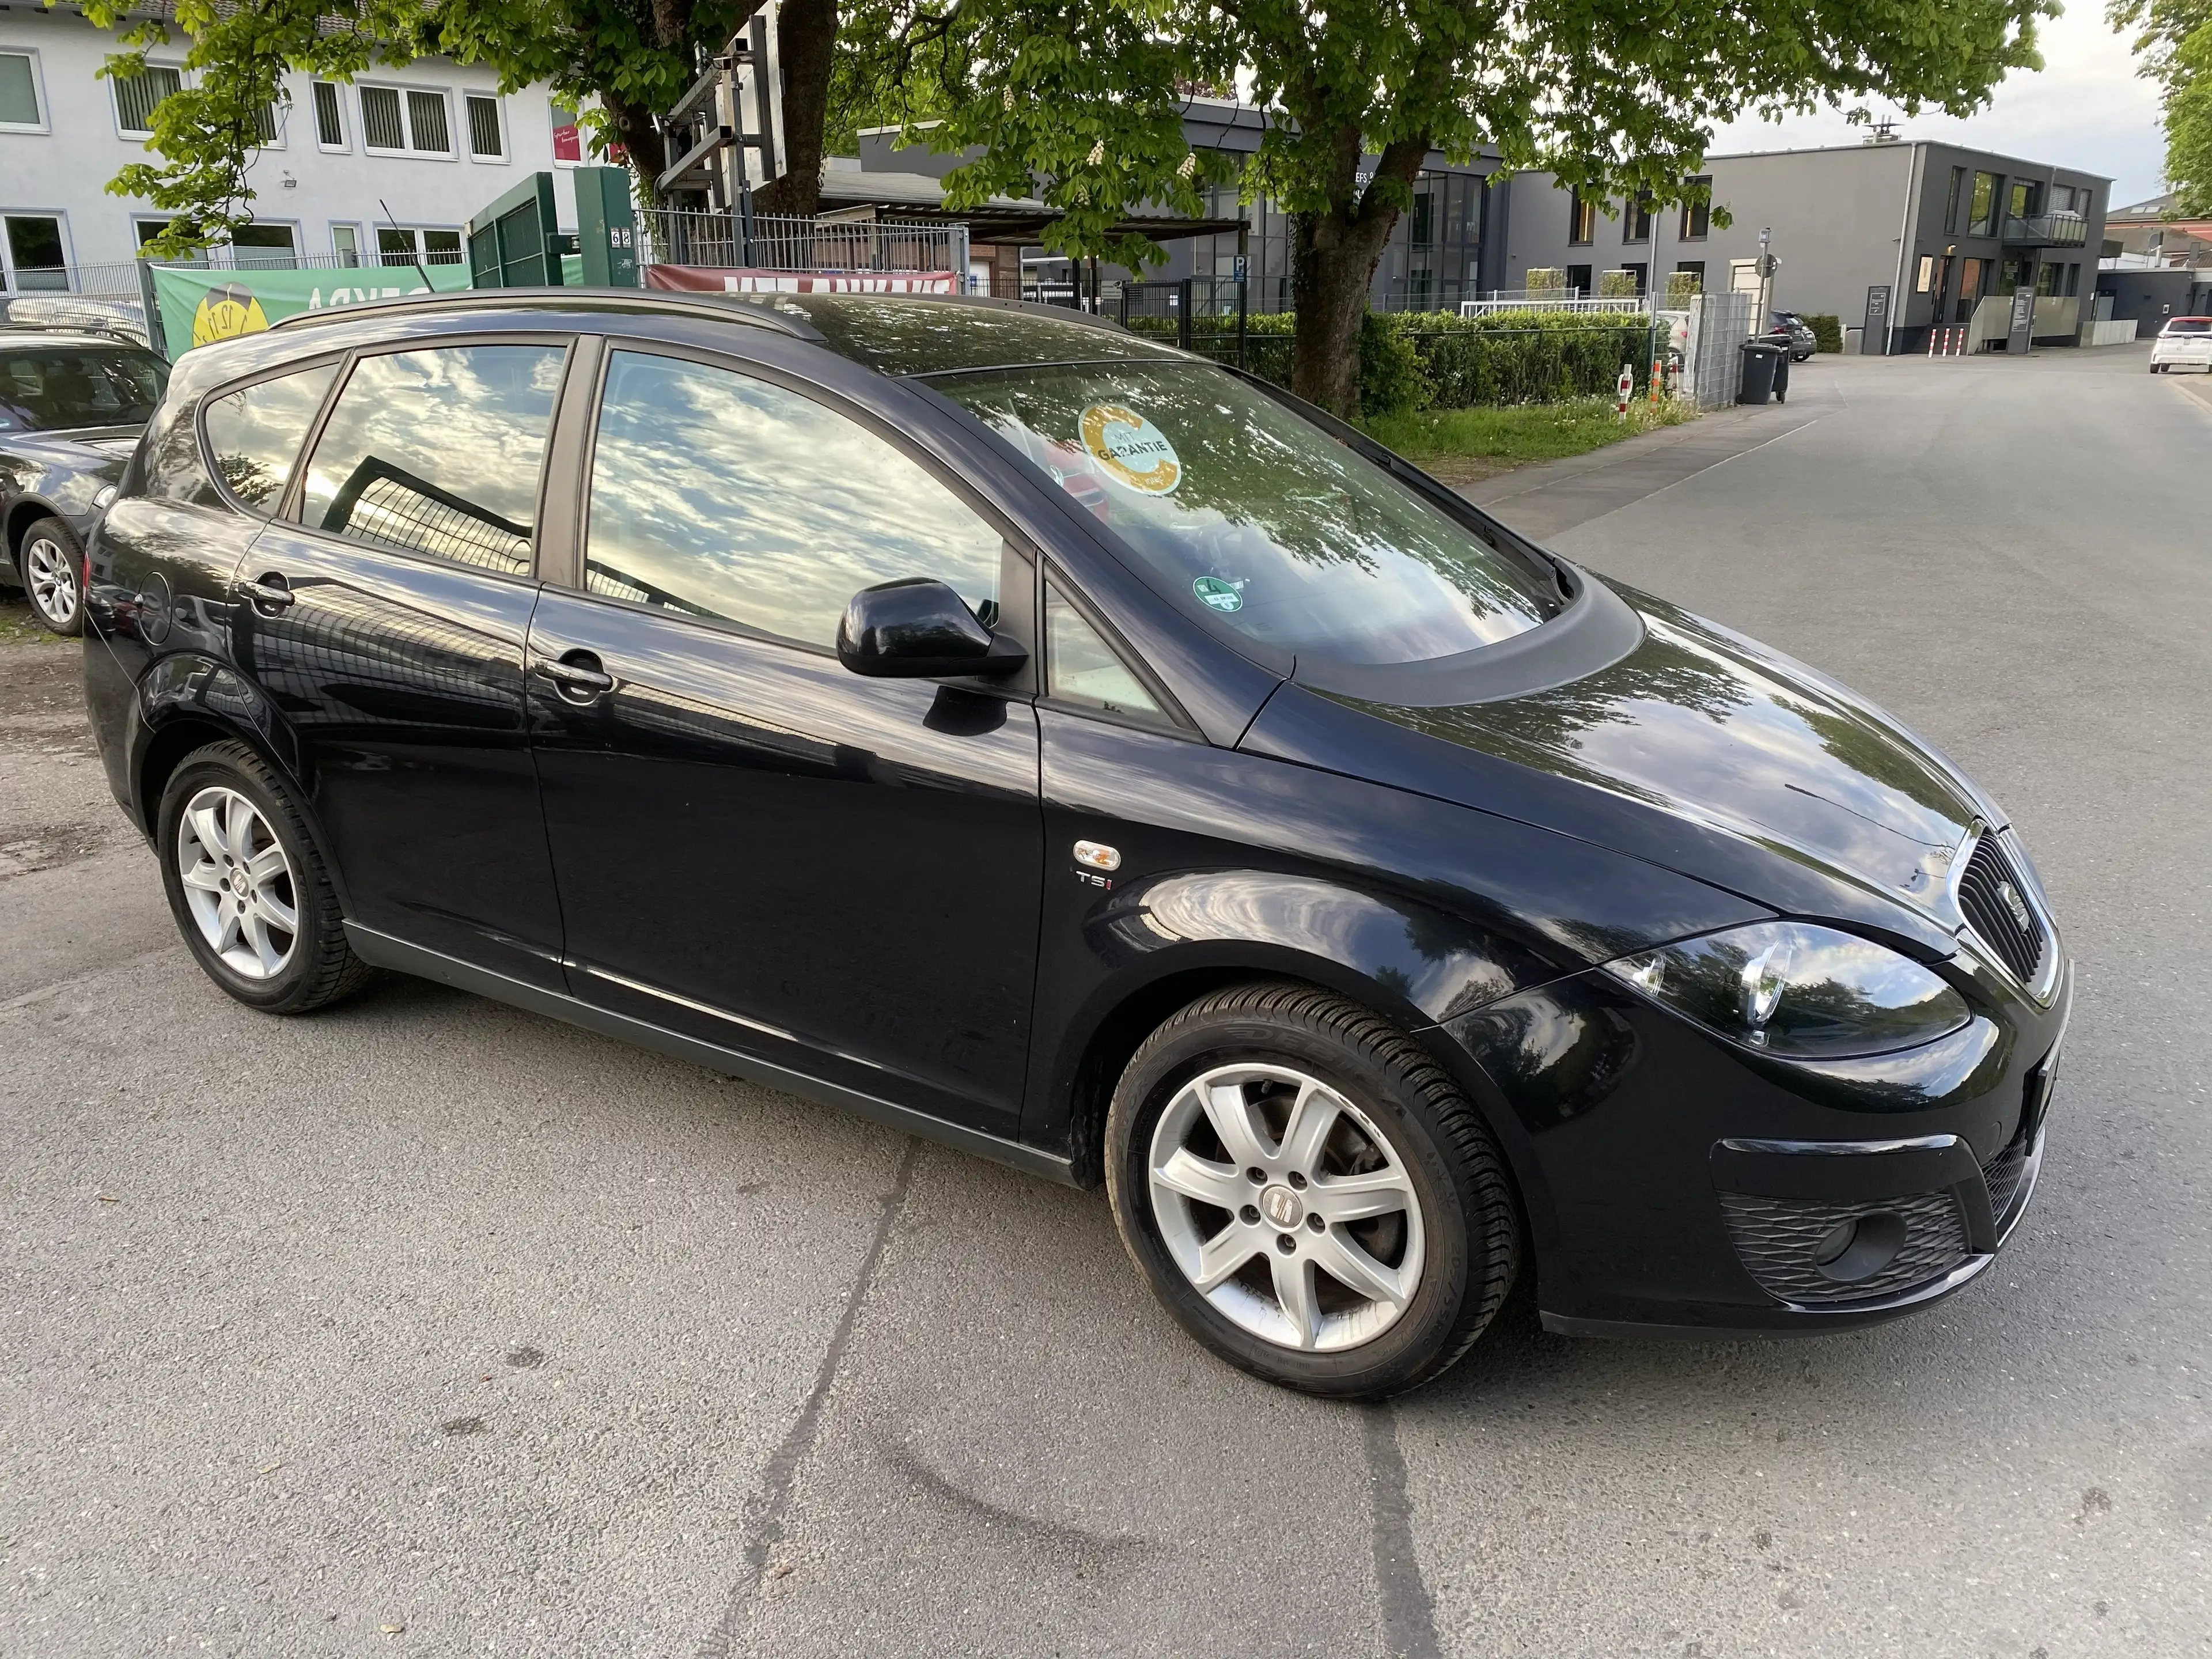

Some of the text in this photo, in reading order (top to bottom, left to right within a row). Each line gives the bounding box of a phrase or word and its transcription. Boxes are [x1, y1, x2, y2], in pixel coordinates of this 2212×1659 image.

[613, 232, 630, 243] 68
[1236, 256, 1245, 271] P
[1114, 432, 1135, 443] MIT
[1097, 441, 1168, 460] GARANTIE
[1206, 579, 1222, 594] 4
